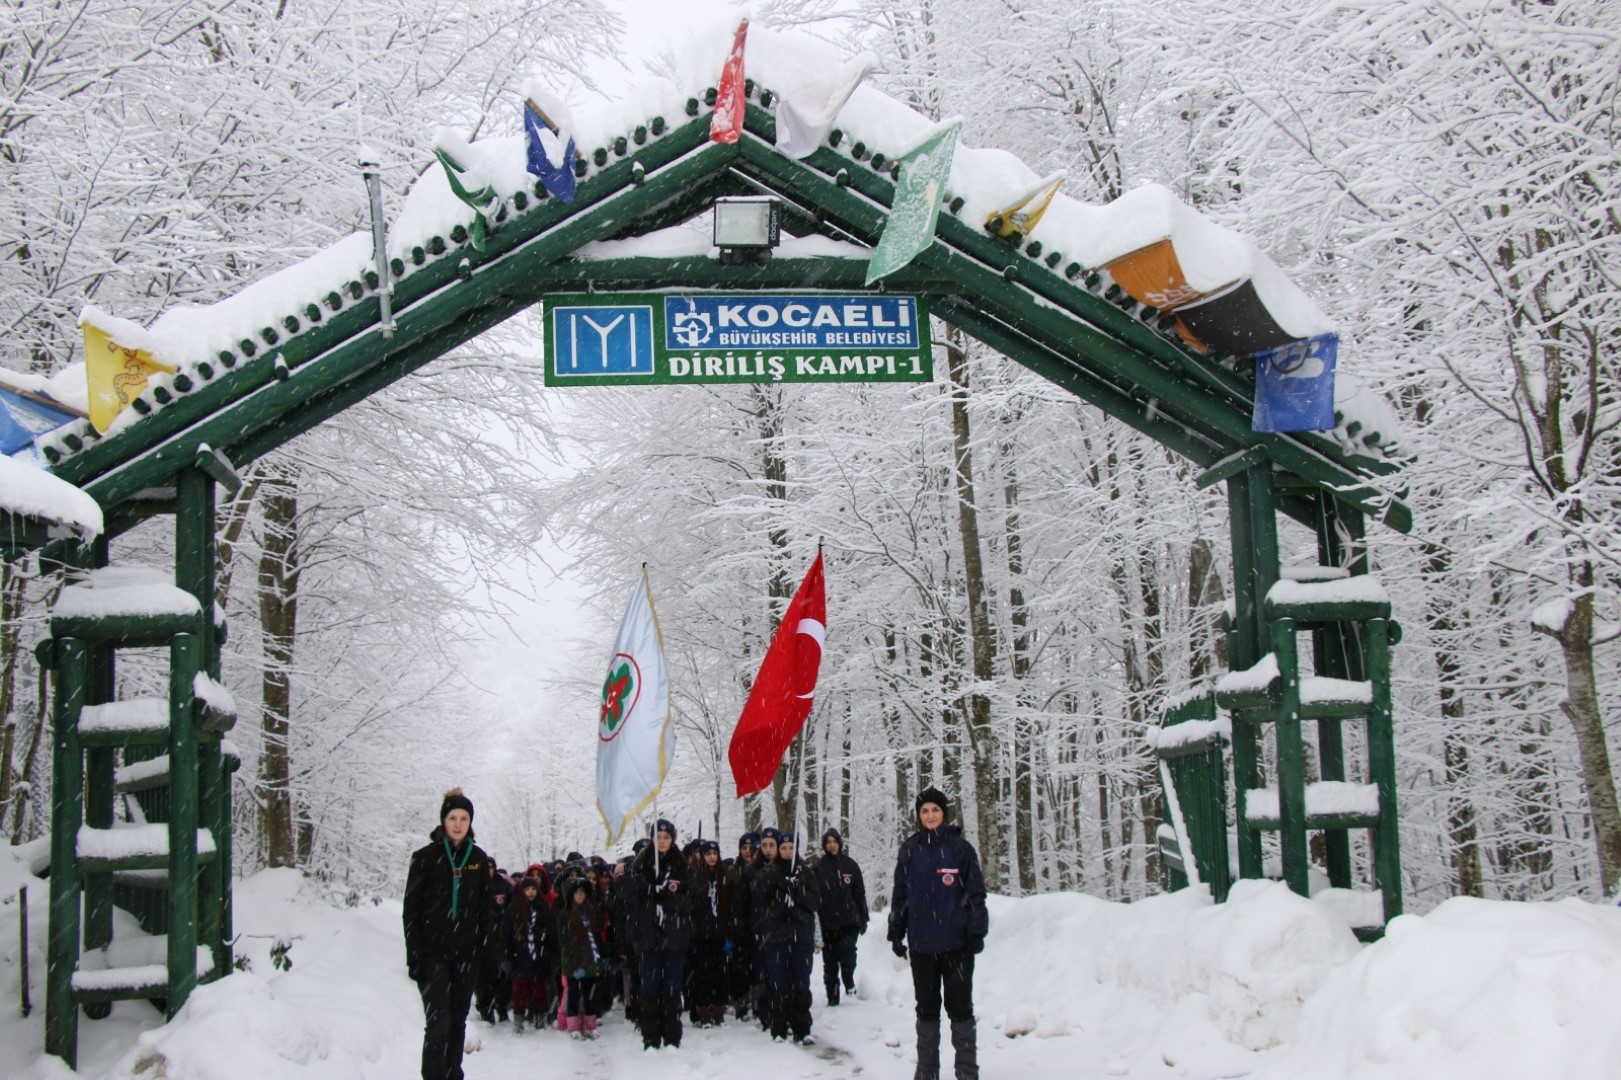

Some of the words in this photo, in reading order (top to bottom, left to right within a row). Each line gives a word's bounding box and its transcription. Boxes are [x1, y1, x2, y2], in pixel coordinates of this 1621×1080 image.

[718, 300, 910, 327] KOCAELİ
[719, 330, 817, 345] BÜYÜKŞEHİR
[826, 330, 911, 344] BELEDİYESİ
[668, 351, 786, 381] DİRİLİŞ
[795, 355, 924, 375] KAMPI-1
